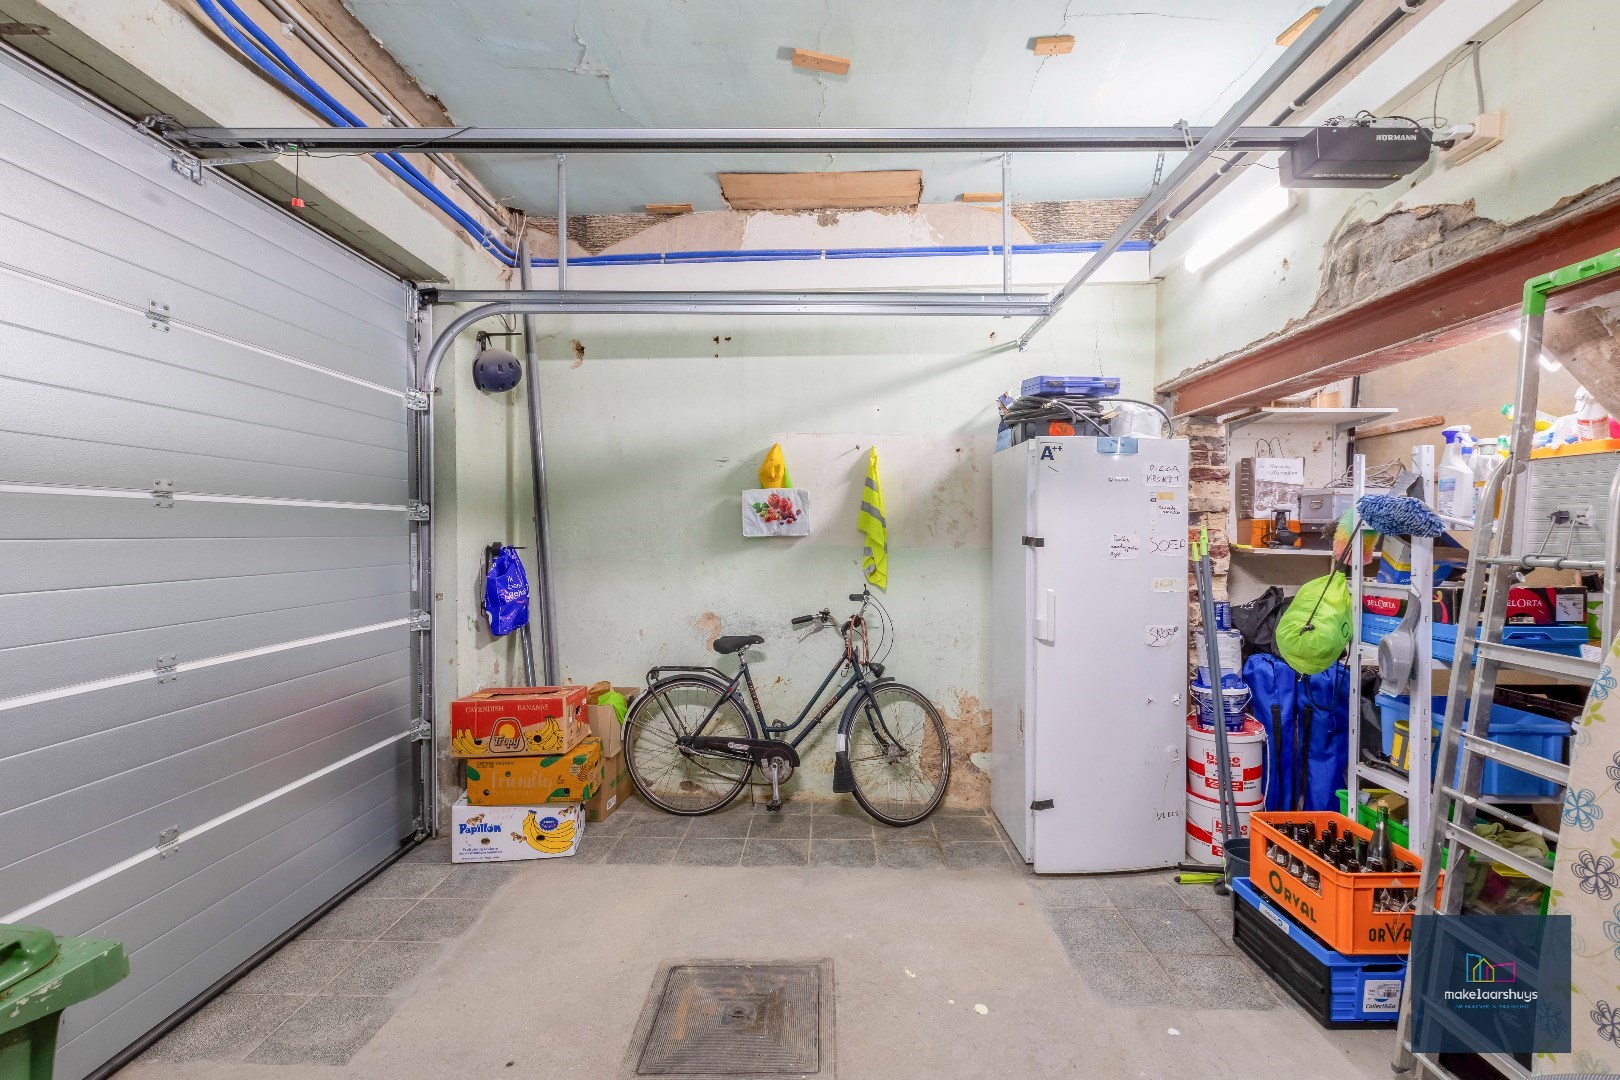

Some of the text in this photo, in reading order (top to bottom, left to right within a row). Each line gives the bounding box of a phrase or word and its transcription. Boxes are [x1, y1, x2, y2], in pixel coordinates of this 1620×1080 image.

[1149, 536, 1187, 554] SOEP
[1506, 599, 1543, 608] ELORTA
[465, 703, 549, 713] CAVENDISH BANANAS
[459, 823, 502, 835] Papillon
[1268, 870, 1317, 923] ORVAL
[1368, 922, 1412, 943] ORVA
